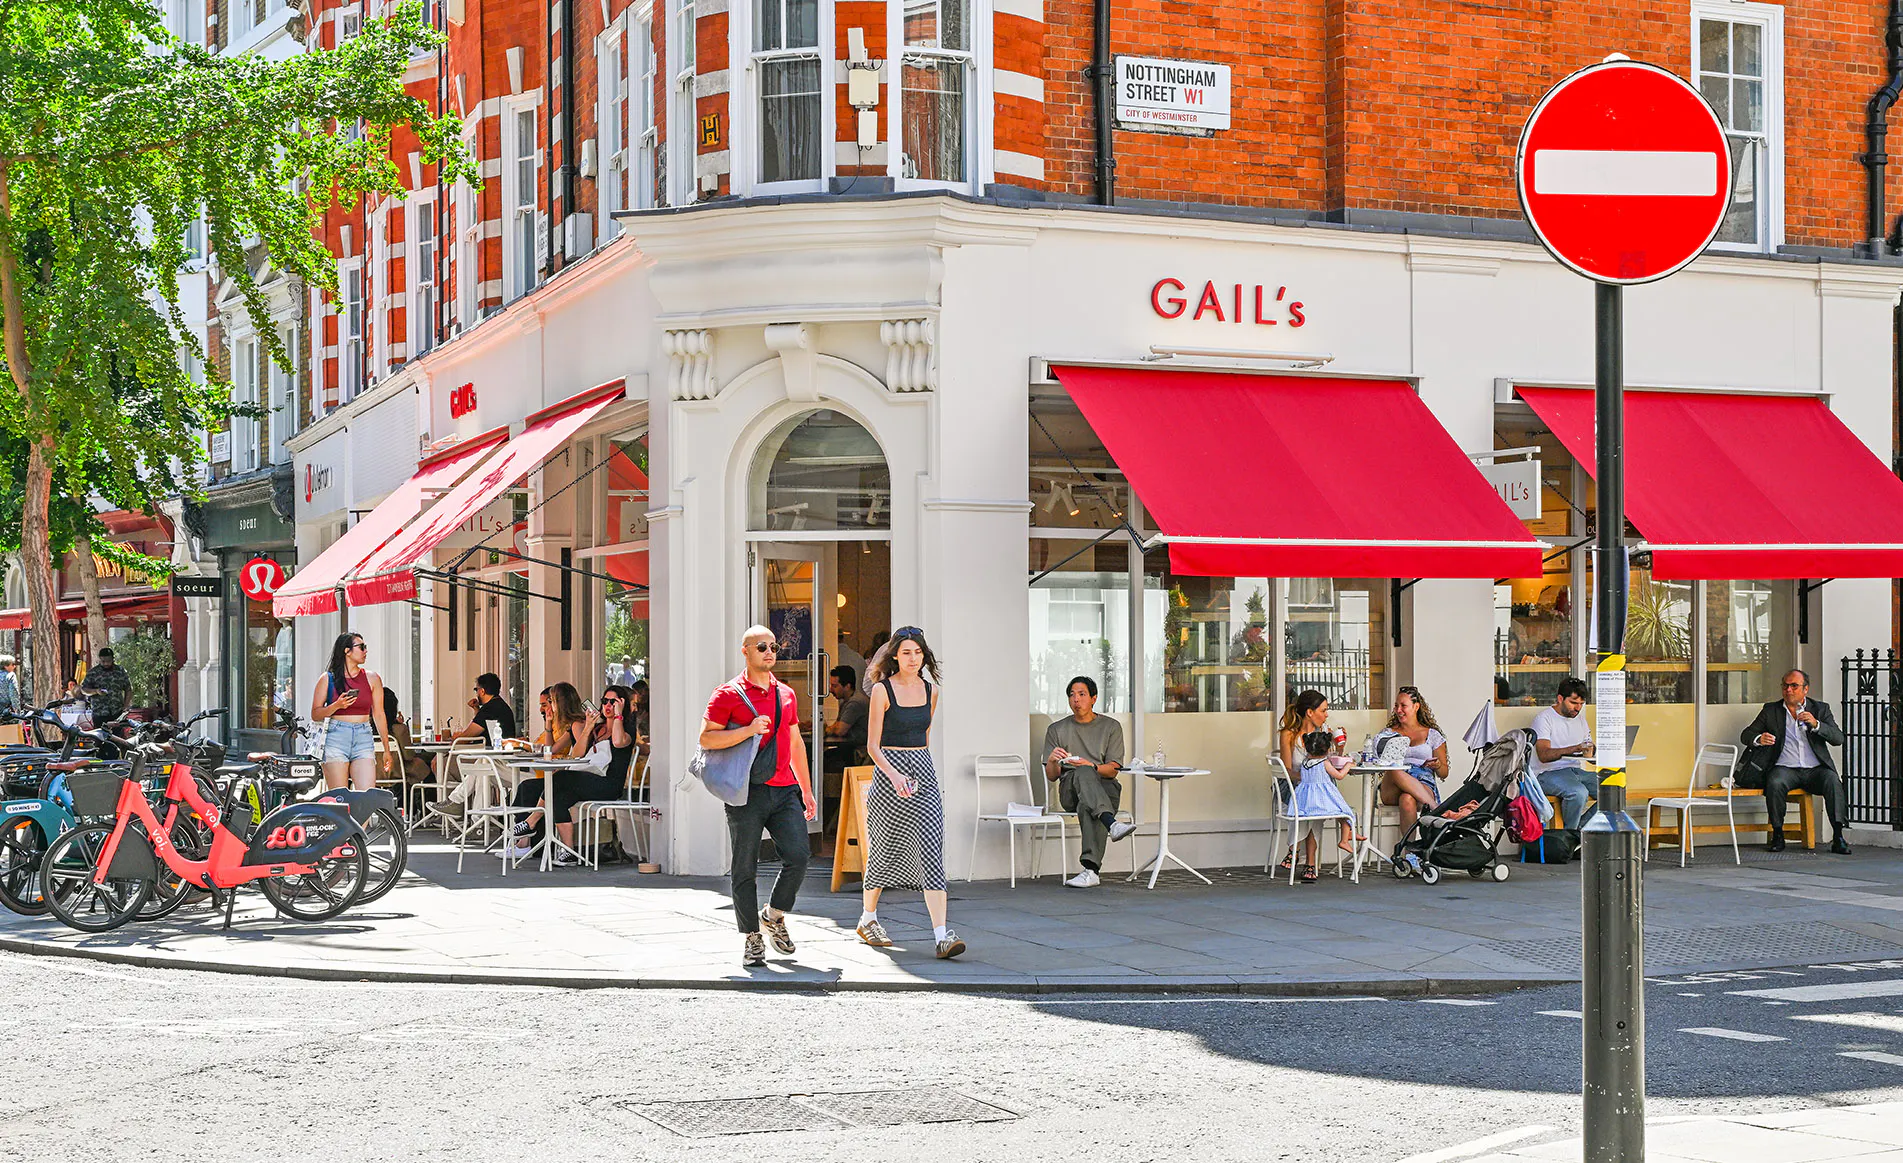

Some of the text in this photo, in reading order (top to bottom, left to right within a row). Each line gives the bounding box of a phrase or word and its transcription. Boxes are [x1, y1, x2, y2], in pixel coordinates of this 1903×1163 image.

[1126, 63, 1216, 88] NOTTINGHAM
[1126, 83, 1203, 105] STREET W1
[1125, 109, 1198, 123] CITY OF WESTMINSTER
[1151, 277, 1305, 328] GAIL's
[239, 517, 257, 531] soeur
[176, 584, 214, 593] soeur
[267, 825, 306, 849] £0
